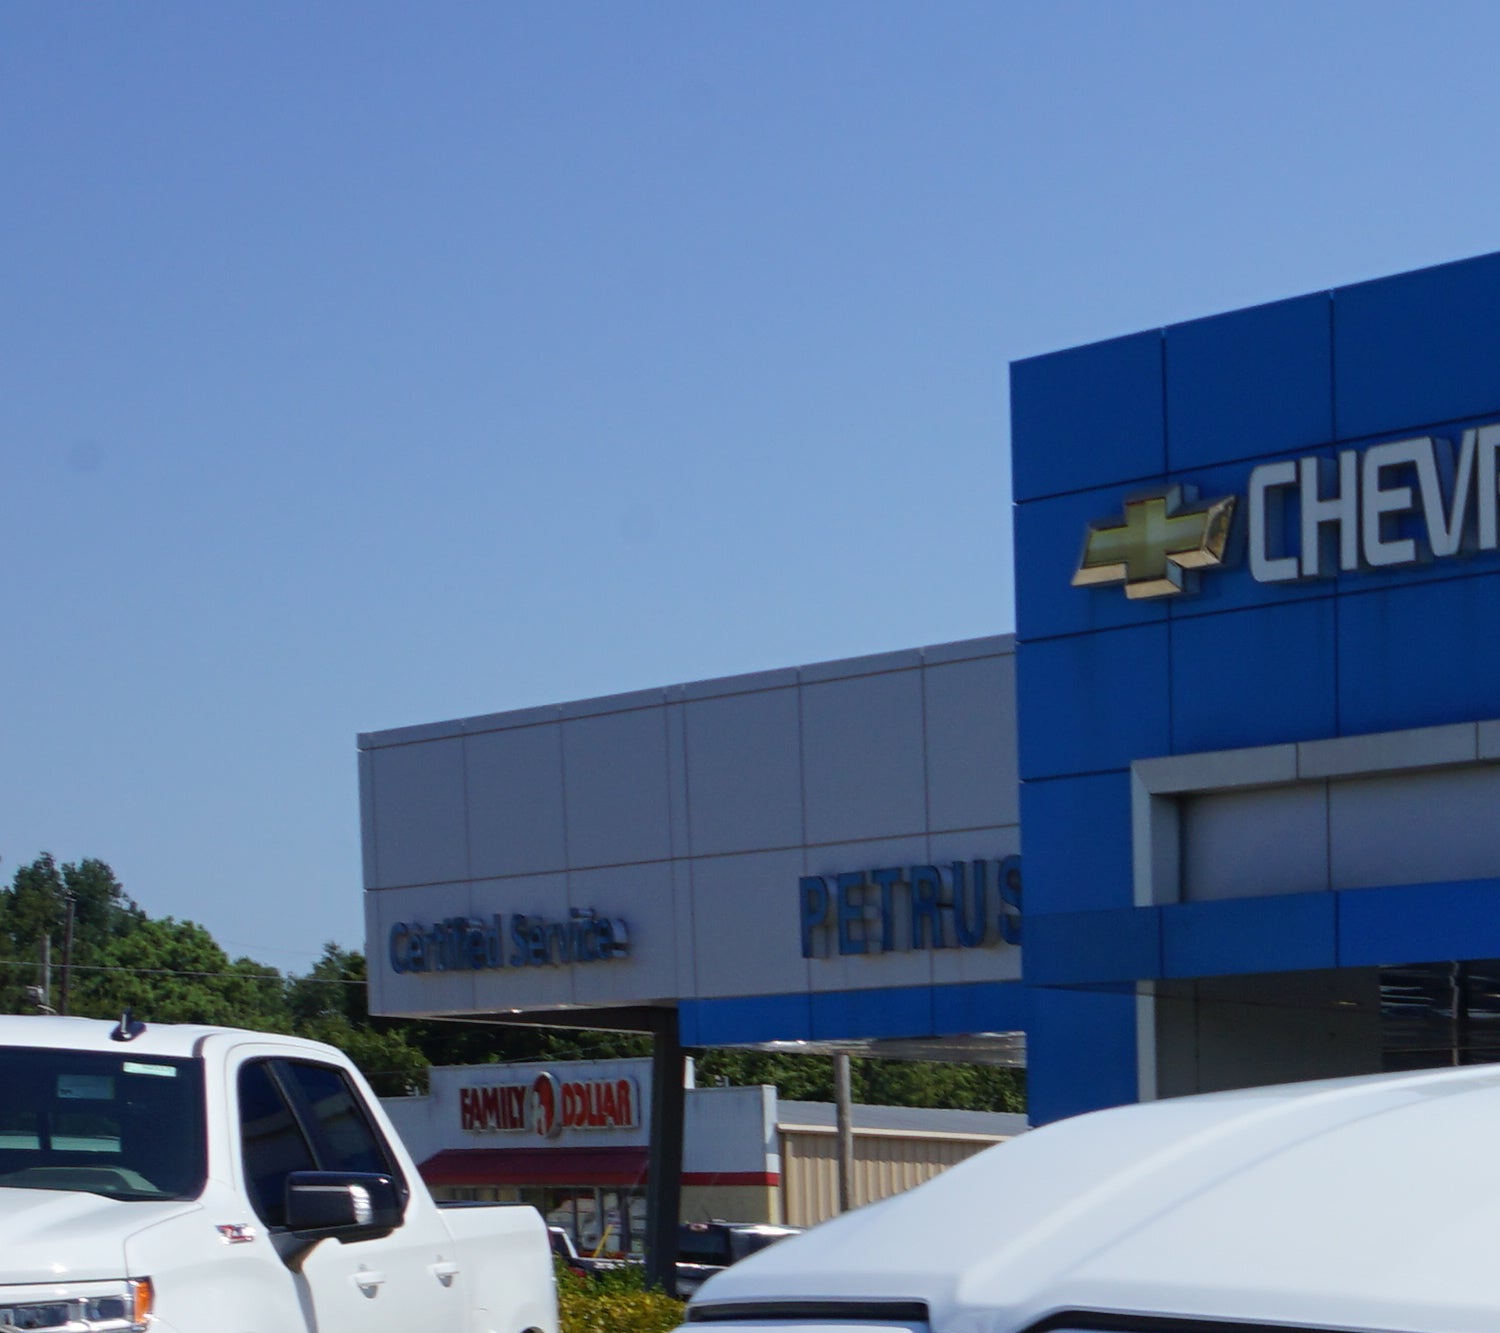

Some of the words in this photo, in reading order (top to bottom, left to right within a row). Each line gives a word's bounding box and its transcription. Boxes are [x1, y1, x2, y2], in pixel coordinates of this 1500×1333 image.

[389, 915, 504, 975] Certified
[509, 906, 632, 968] Service
[798, 854, 1022, 959] PETRUS
[459, 1085, 528, 1132] FAMILY
[560, 1079, 640, 1129] DOLLAR
